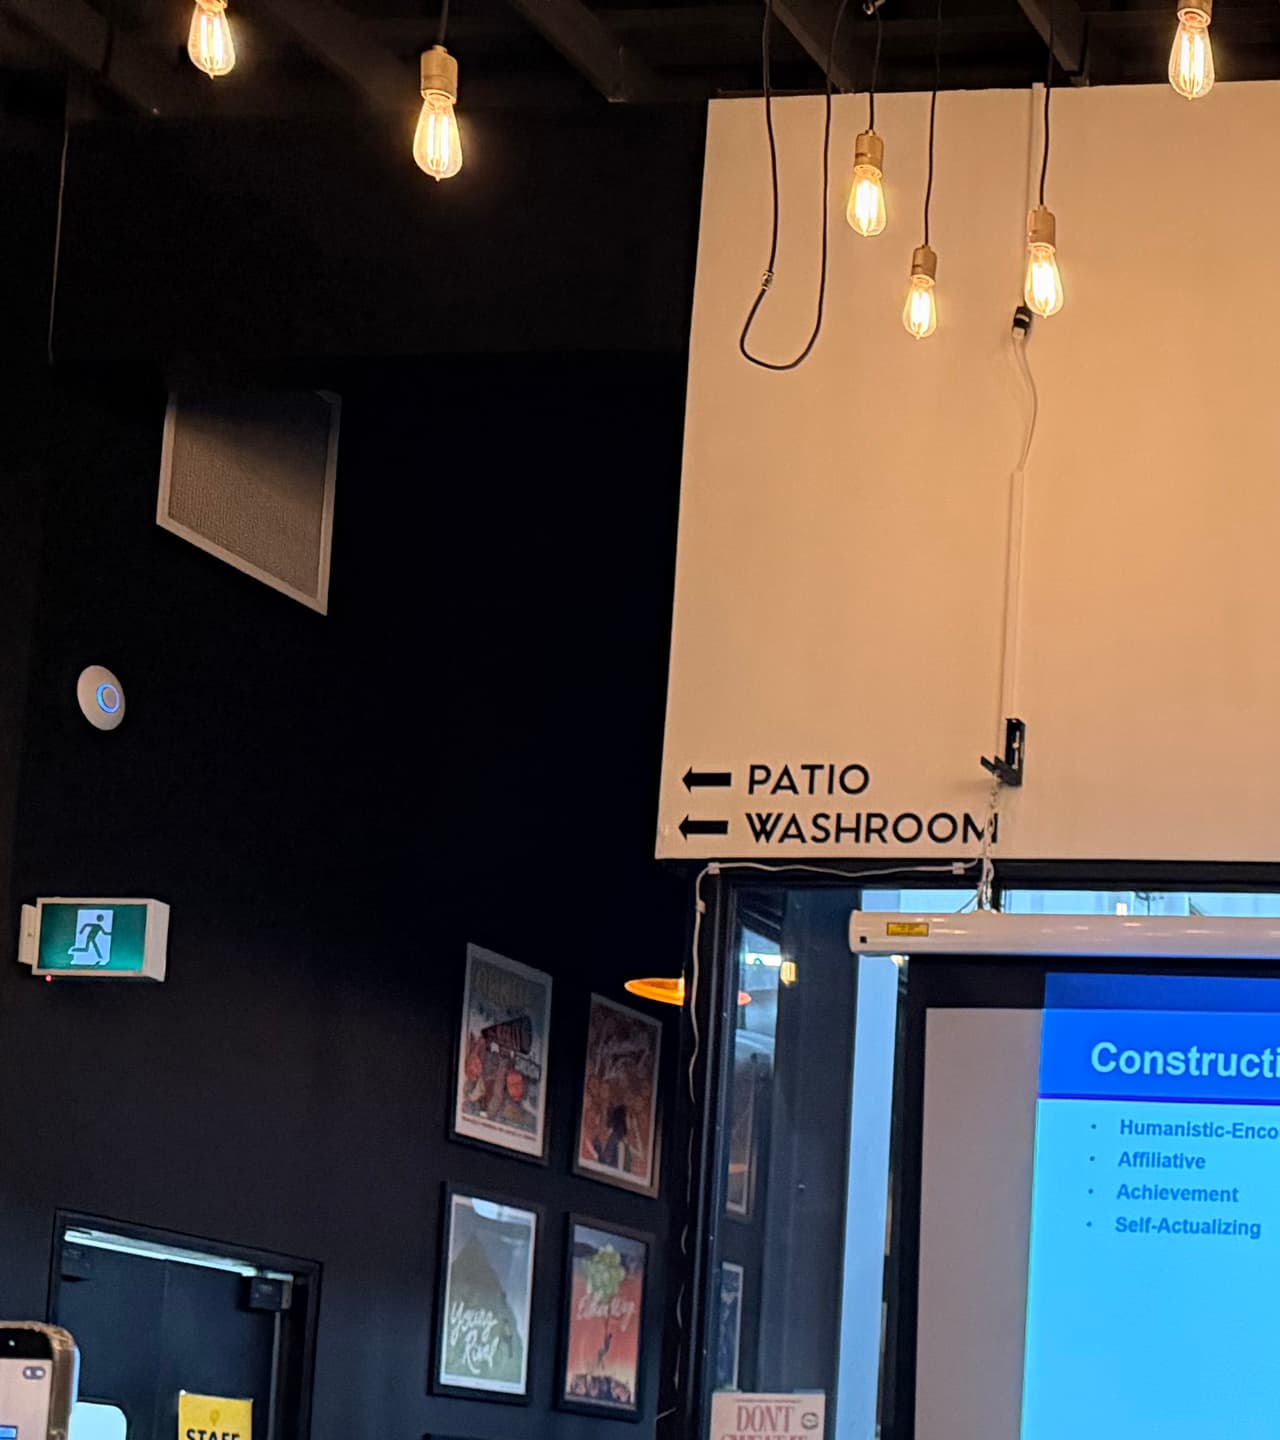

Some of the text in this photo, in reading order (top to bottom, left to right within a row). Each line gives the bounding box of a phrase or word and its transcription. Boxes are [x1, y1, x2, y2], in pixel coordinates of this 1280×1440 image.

[747, 763, 870, 795] PATIO
[744, 812, 998, 844] WASHROOM
[1117, 1151, 1206, 1170] Affiliative
[1115, 1183, 1240, 1203] Achievement
[1114, 1216, 1262, 1240] Self-Actualizing
